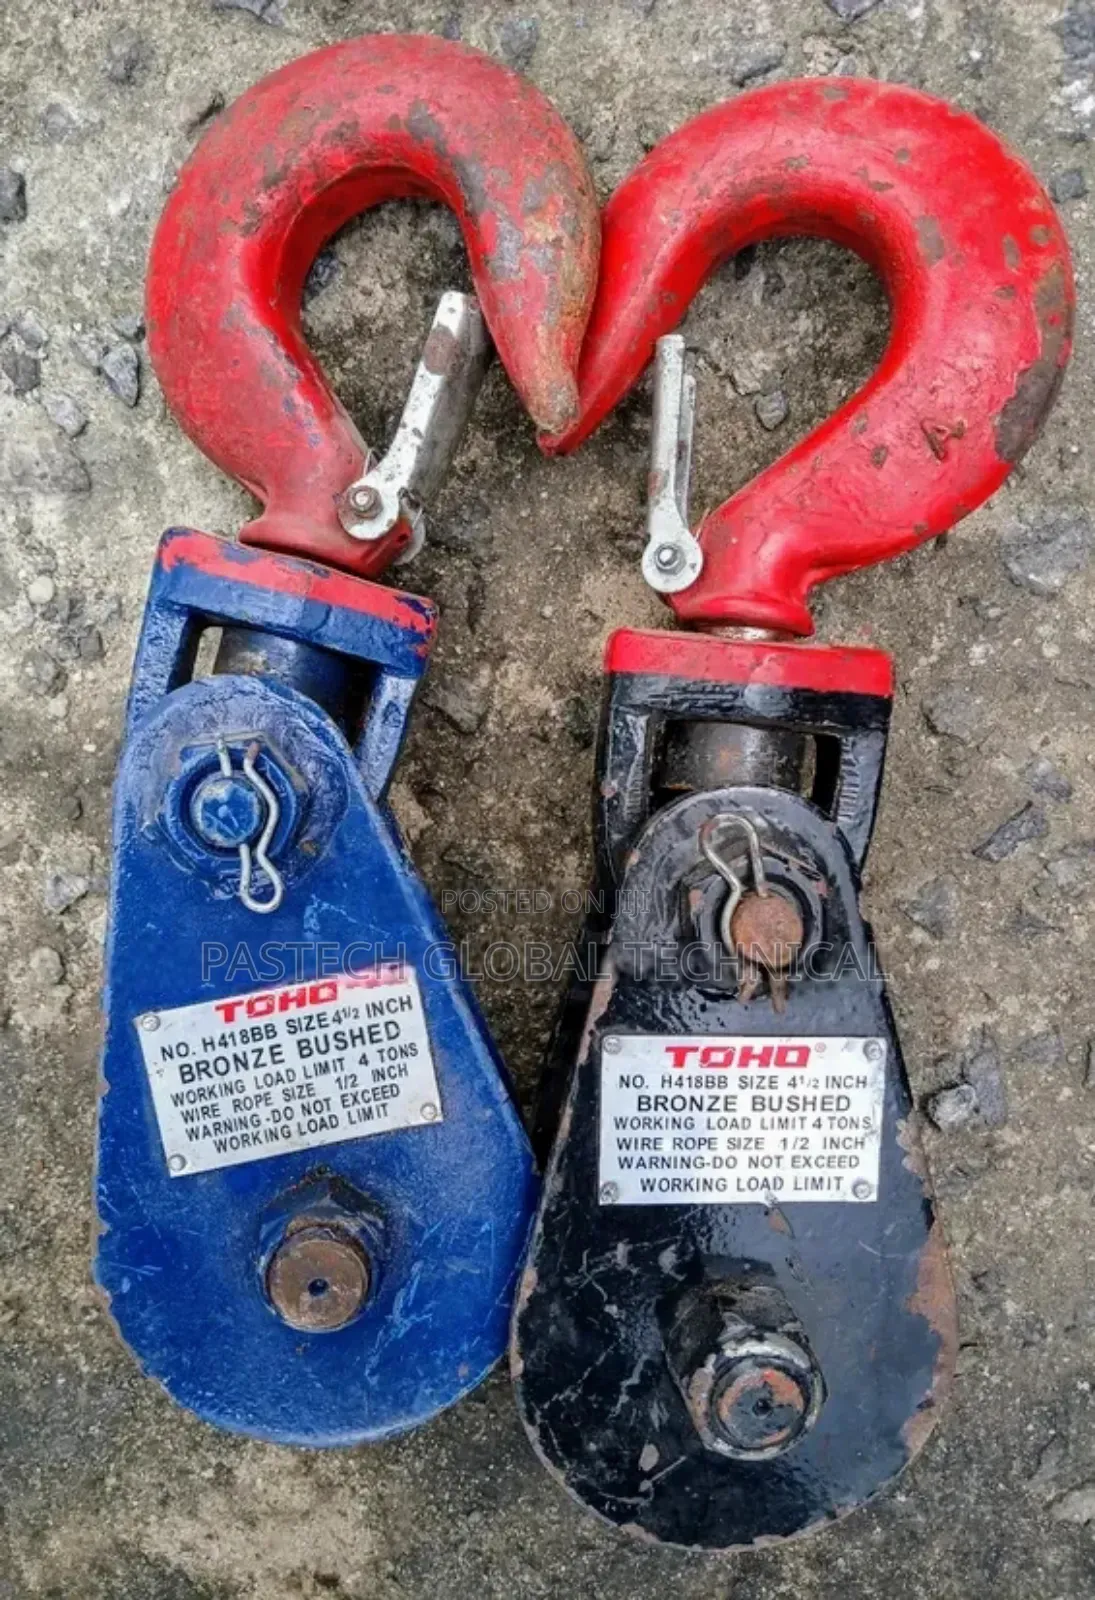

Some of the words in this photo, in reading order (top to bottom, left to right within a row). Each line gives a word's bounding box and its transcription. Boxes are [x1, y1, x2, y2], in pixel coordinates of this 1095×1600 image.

[214, 981, 338, 1023] TOHO
[160, 1041, 196, 1062] NO.
[201, 1023, 278, 1053] H418BB
[285, 1011, 330, 1035] SIZE
[365, 994, 413, 1019] INCH
[178, 1043, 286, 1085] BRONZE
[296, 1020, 401, 1059] BUSHED
[170, 1079, 246, 1108] WORKING
[253, 1067, 297, 1090] LOAD
[303, 1057, 346, 1080] LIMIT
[358, 1052, 369, 1067] 4
[376, 1042, 419, 1063] TONS
[618, 1074, 649, 1090] NO.
[660, 1074, 729, 1090] H418BB
[738, 1074, 779, 1090] SIZE
[825, 1074, 868, 1090] INCH
[180, 1102, 221, 1125] WIRE
[232, 1091, 274, 1114] ROPE
[281, 1082, 316, 1103] SIZE
[335, 1073, 358, 1091] 1/2
[371, 1062, 409, 1083] INCH
[301, 1097, 332, 1117] NOT
[340, 1083, 401, 1110] EXCEED
[636, 1094, 738, 1113] BRONZE
[751, 1094, 852, 1113] BUSHED
[213, 1124, 292, 1154] WORKING
[297, 1113, 339, 1136] LOAD
[347, 1103, 389, 1125] LIMIT
[613, 1116, 696, 1131] WORKING
[706, 1116, 751, 1131] LOAD
[760, 1116, 808, 1131] LIMIT
[812, 1116, 823, 1131] 4
[828, 1116, 873, 1131] TONS
[616, 1136, 664, 1151] WIRE
[672, 1136, 719, 1151] ROPE
[726, 1136, 765, 1151] SIZE
[780, 1136, 810, 1151] 1/2
[822, 1136, 866, 1151] INCH
[747, 1154, 785, 1170] NOT
[790, 1154, 861, 1170] EXCEED
[640, 1177, 728, 1193] WORKING
[736, 1176, 785, 1192] LOAD
[793, 1175, 844, 1192] LIMIT
